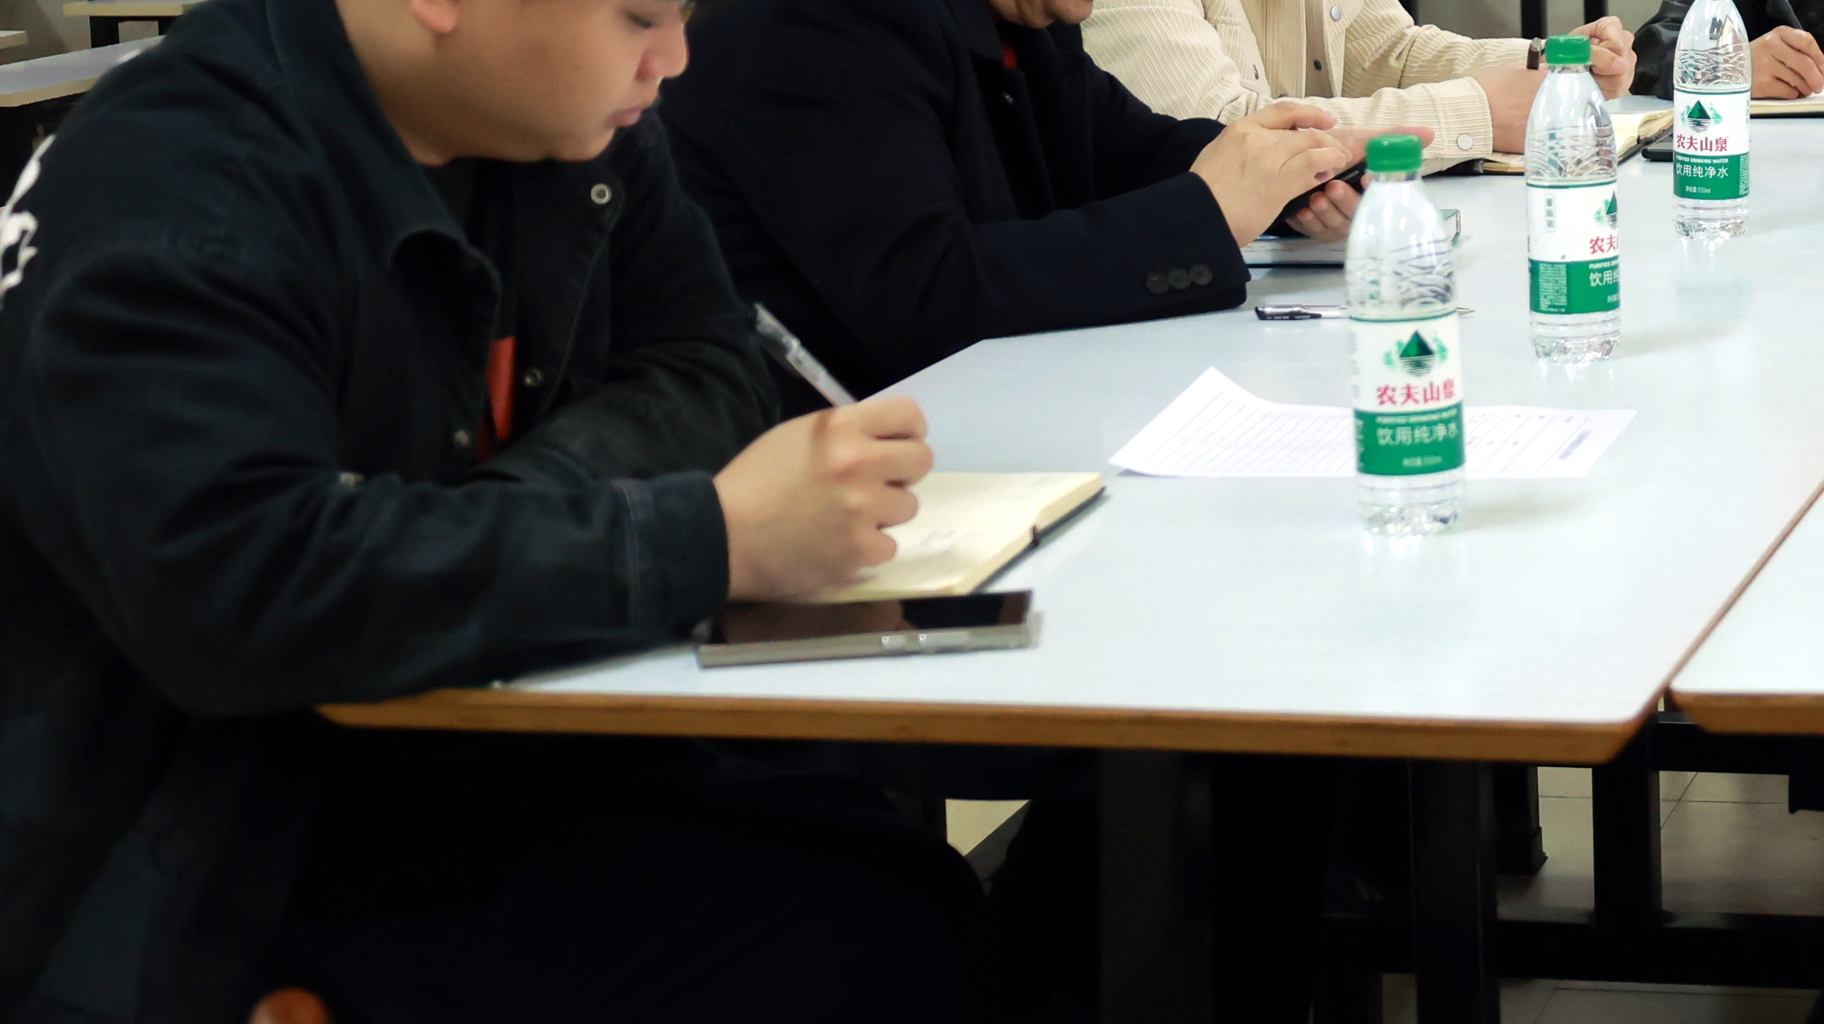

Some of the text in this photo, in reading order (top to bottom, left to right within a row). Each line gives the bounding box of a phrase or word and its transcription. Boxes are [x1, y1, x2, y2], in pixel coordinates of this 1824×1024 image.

[1676, 134, 1728, 152] 农夫山泉
[1676, 162, 1729, 178] 饮用纯净水
